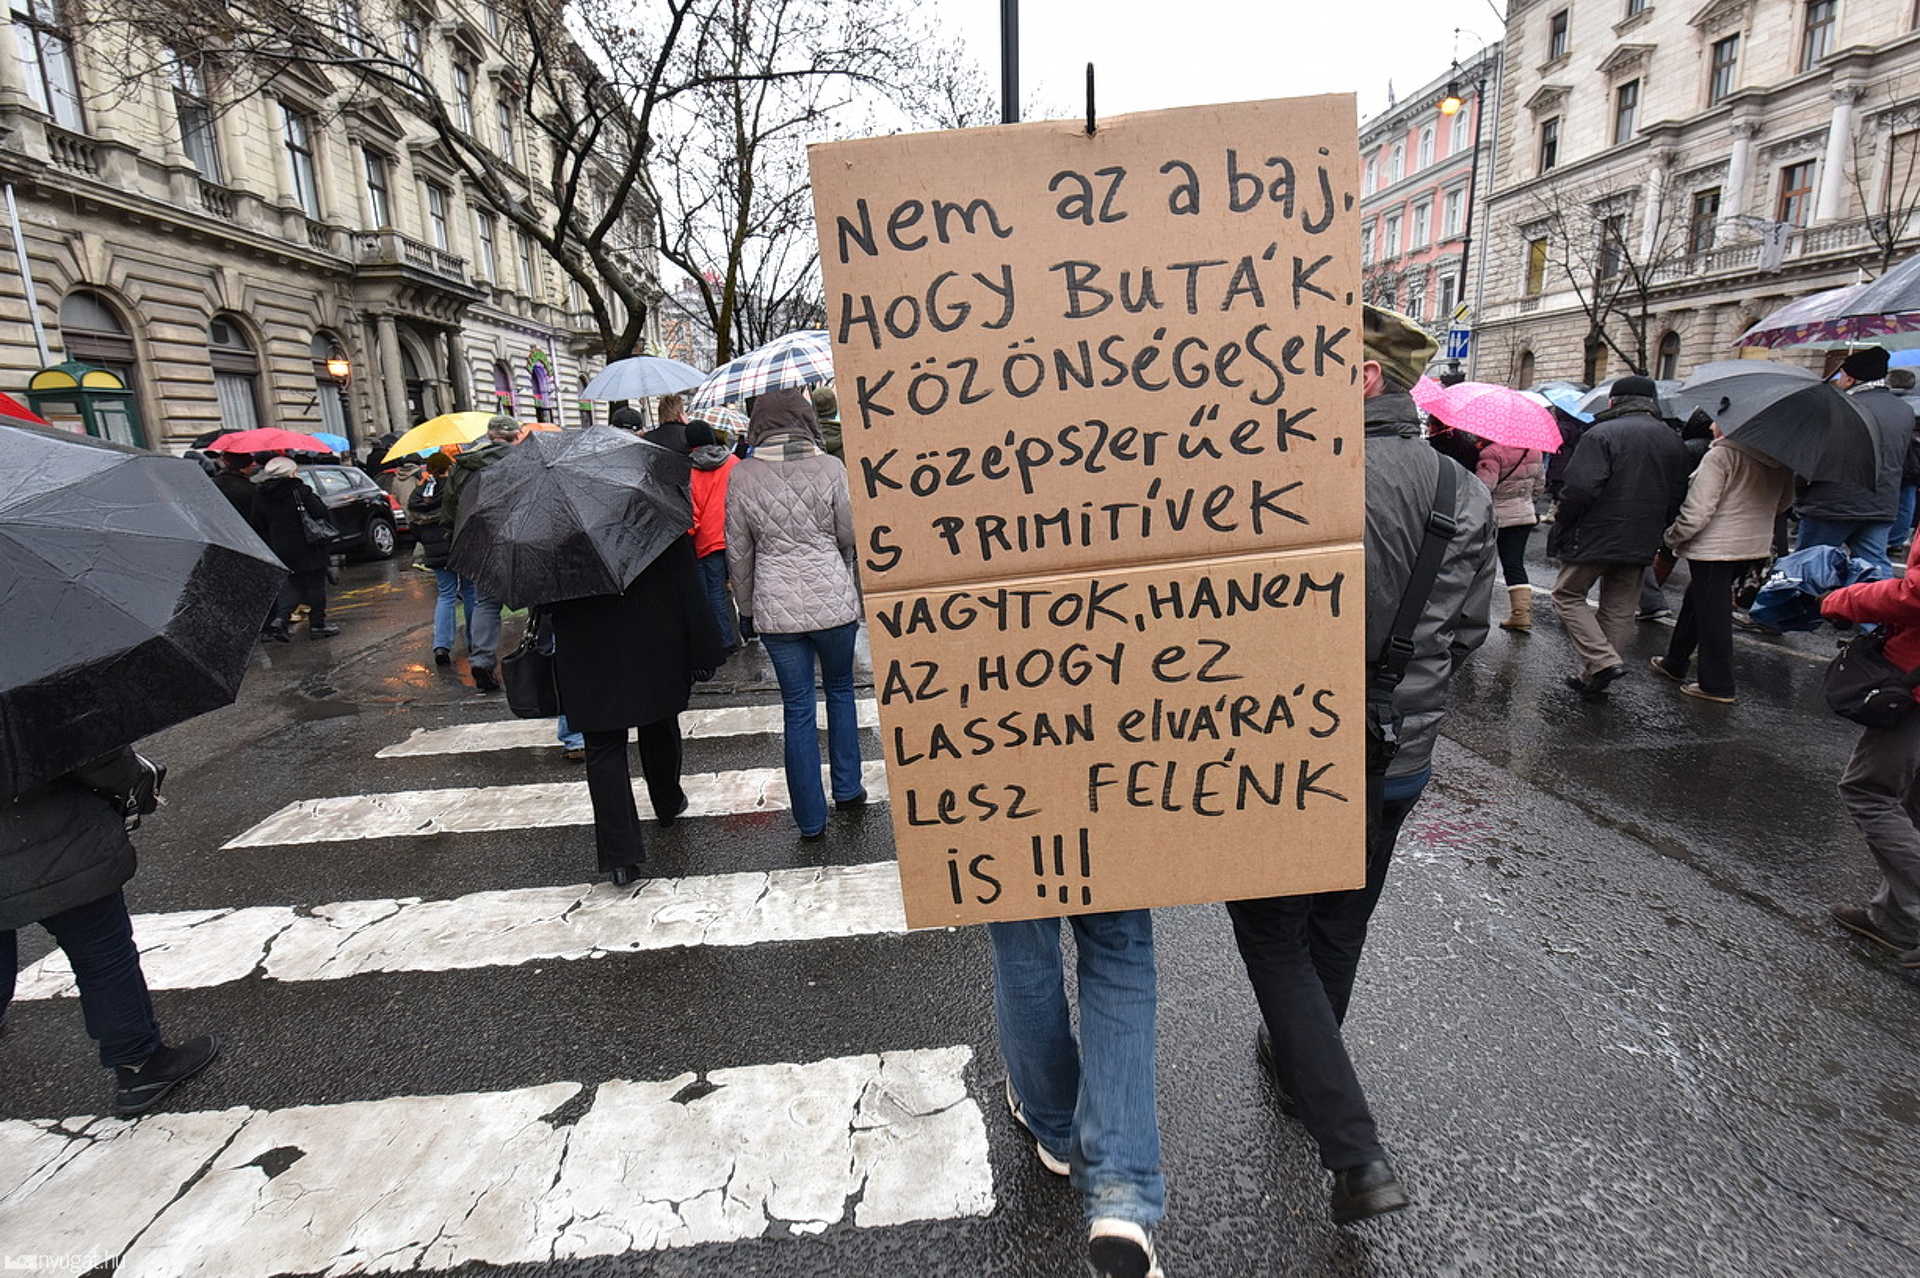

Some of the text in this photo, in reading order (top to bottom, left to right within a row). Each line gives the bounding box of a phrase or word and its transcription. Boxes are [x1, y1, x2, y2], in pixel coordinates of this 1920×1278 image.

[836, 198, 1013, 264] Nem
[1159, 160, 1200, 215] a
[894, 703, 1096, 767] LASSAN
